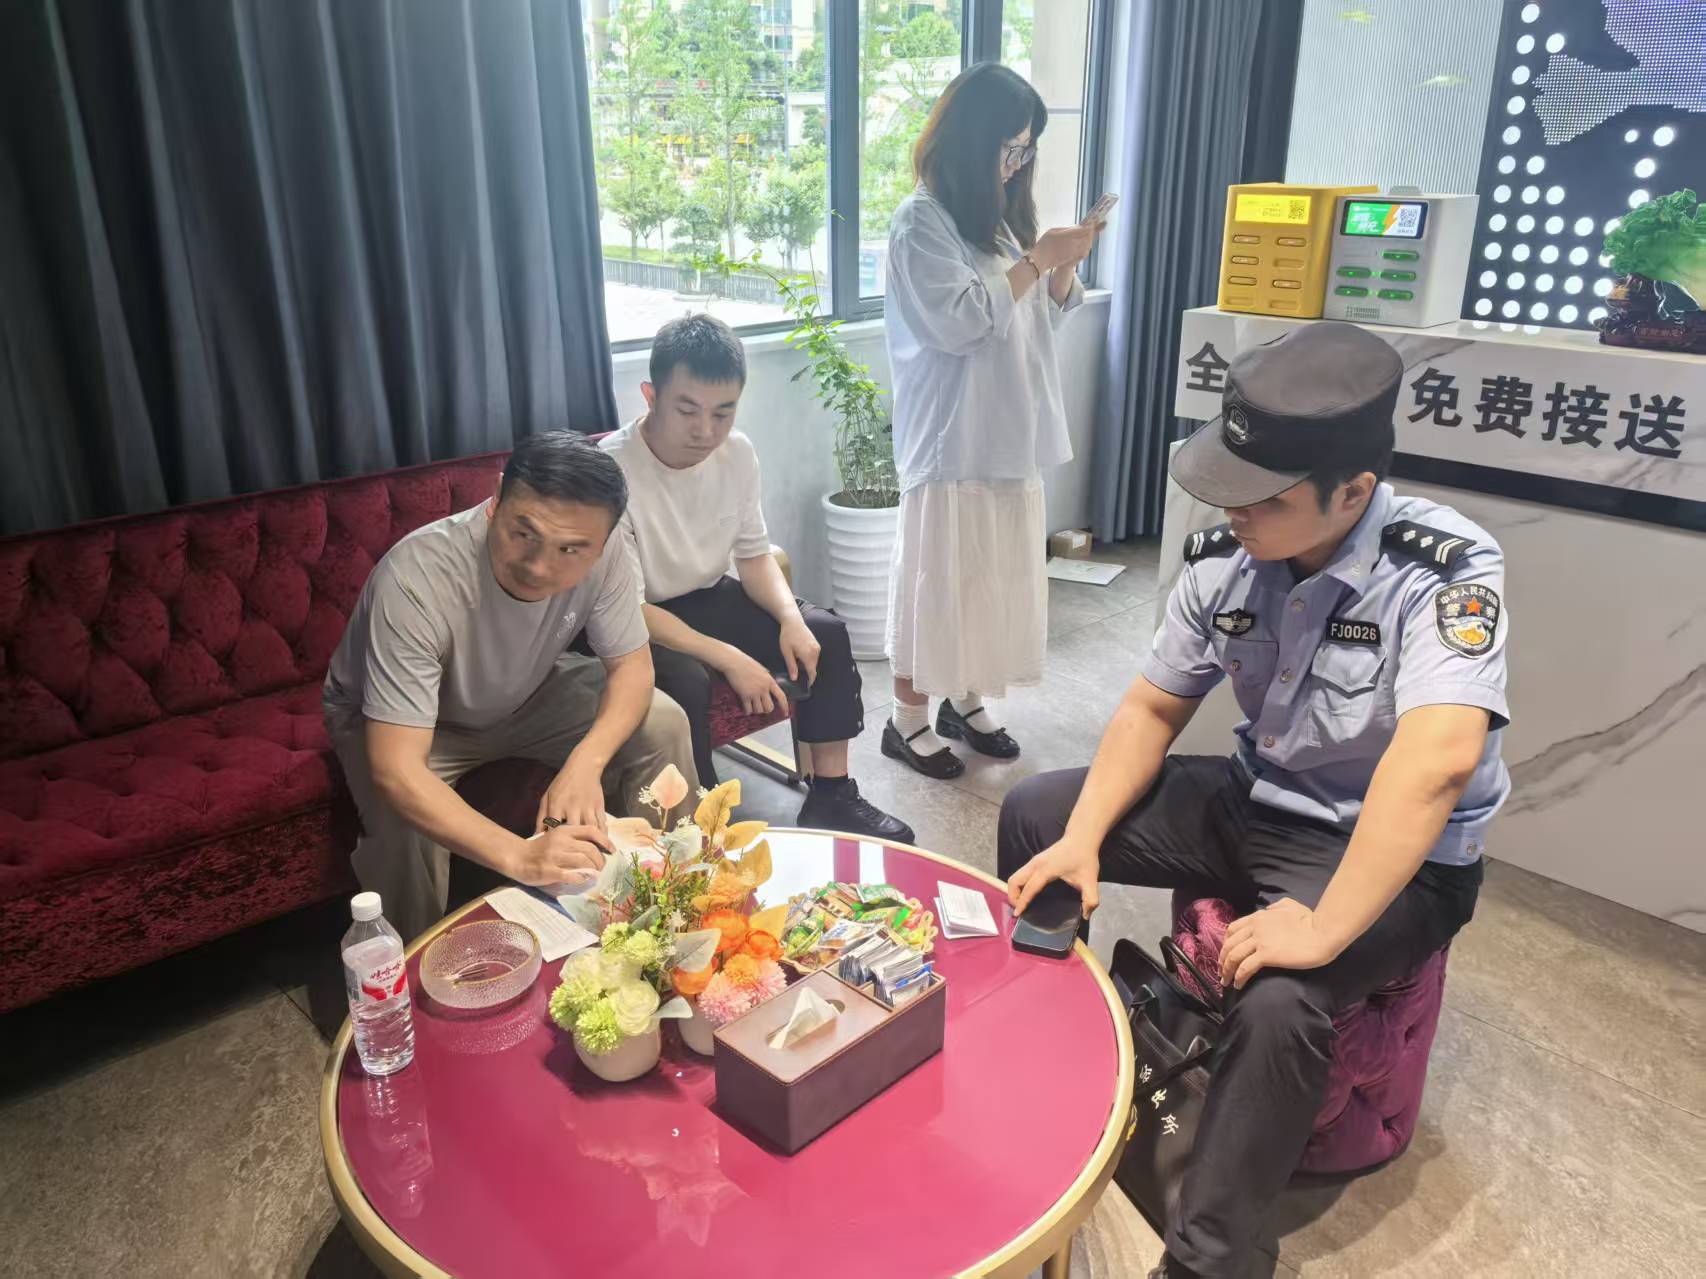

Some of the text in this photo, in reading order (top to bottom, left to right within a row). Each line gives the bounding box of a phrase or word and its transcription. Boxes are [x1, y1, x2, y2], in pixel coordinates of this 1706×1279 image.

[1185, 341, 1686, 460] 全 免费接送
[1330, 622, 1378, 641] FJ0026
